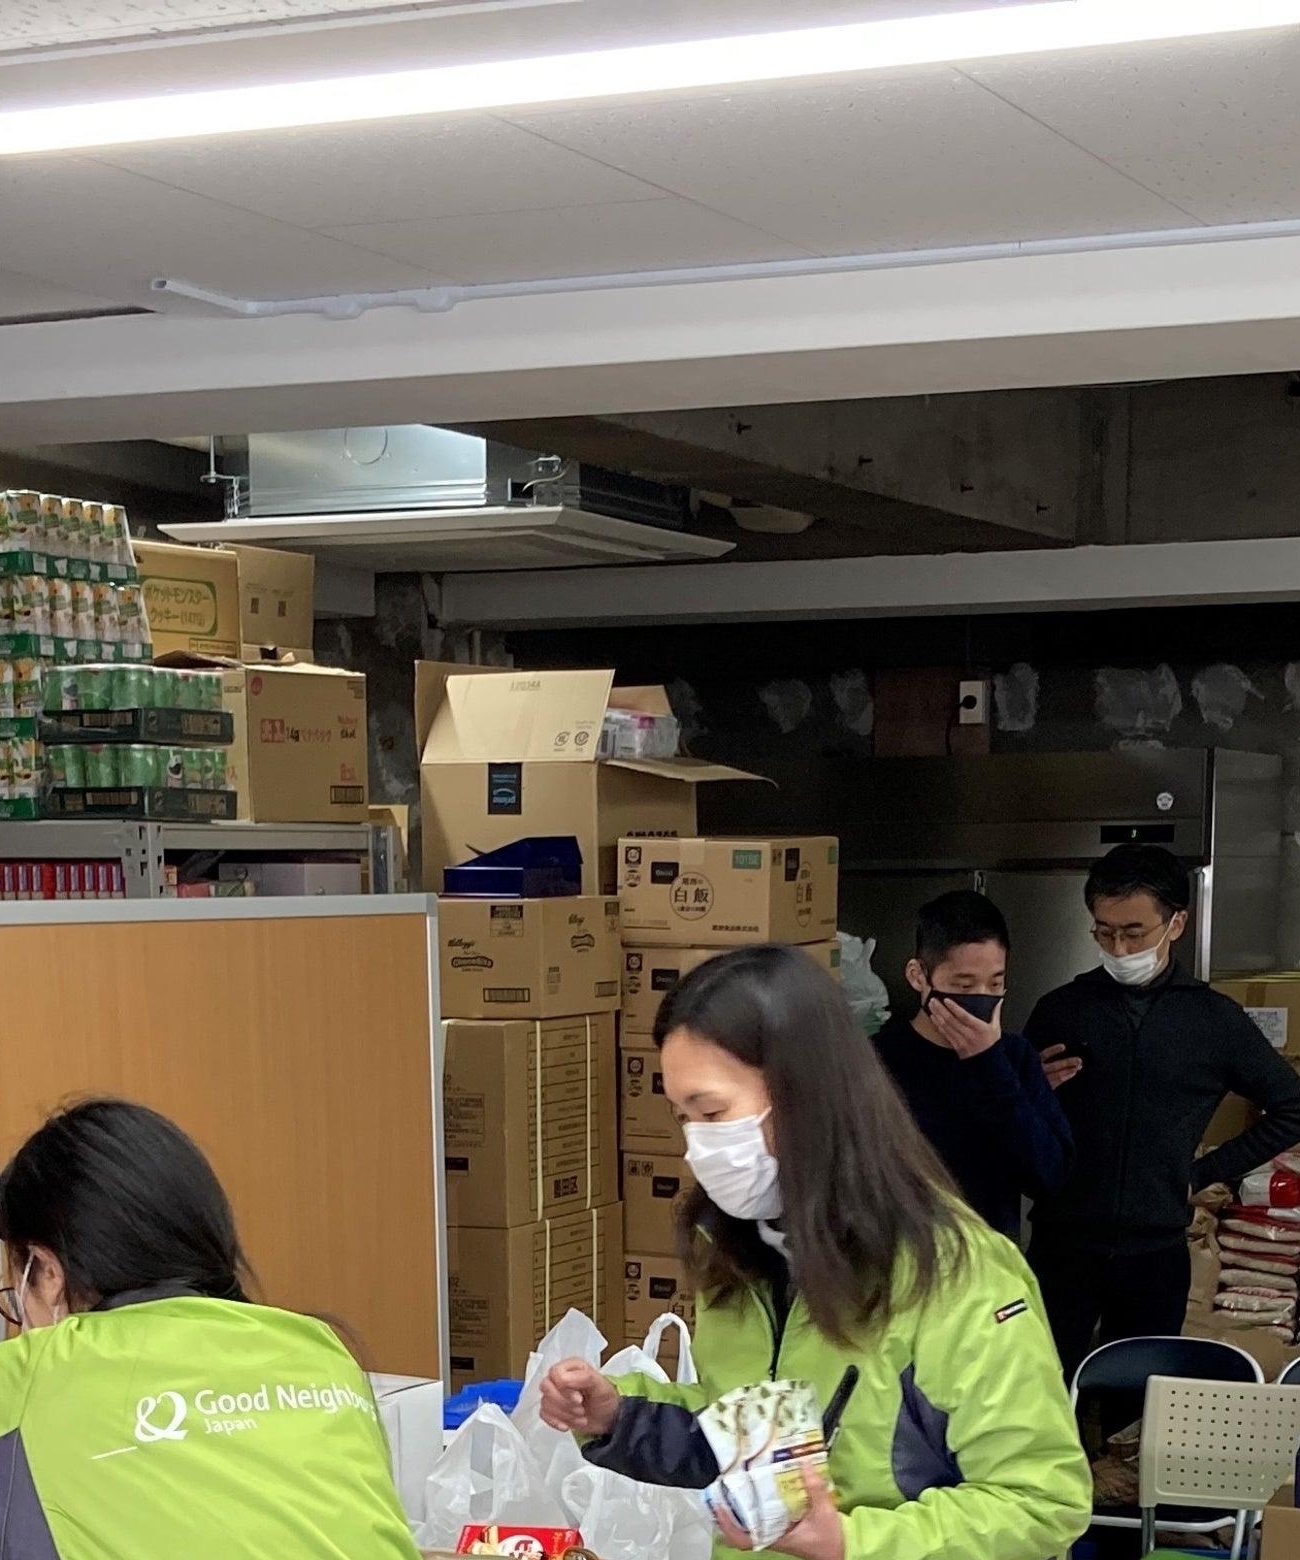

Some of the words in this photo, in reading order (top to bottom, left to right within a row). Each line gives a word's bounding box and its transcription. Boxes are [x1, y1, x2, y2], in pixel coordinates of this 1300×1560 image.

[673, 887, 710, 904] 白飯
[195, 1384, 270, 1415] Good
[203, 1417, 258, 1435] Japan
